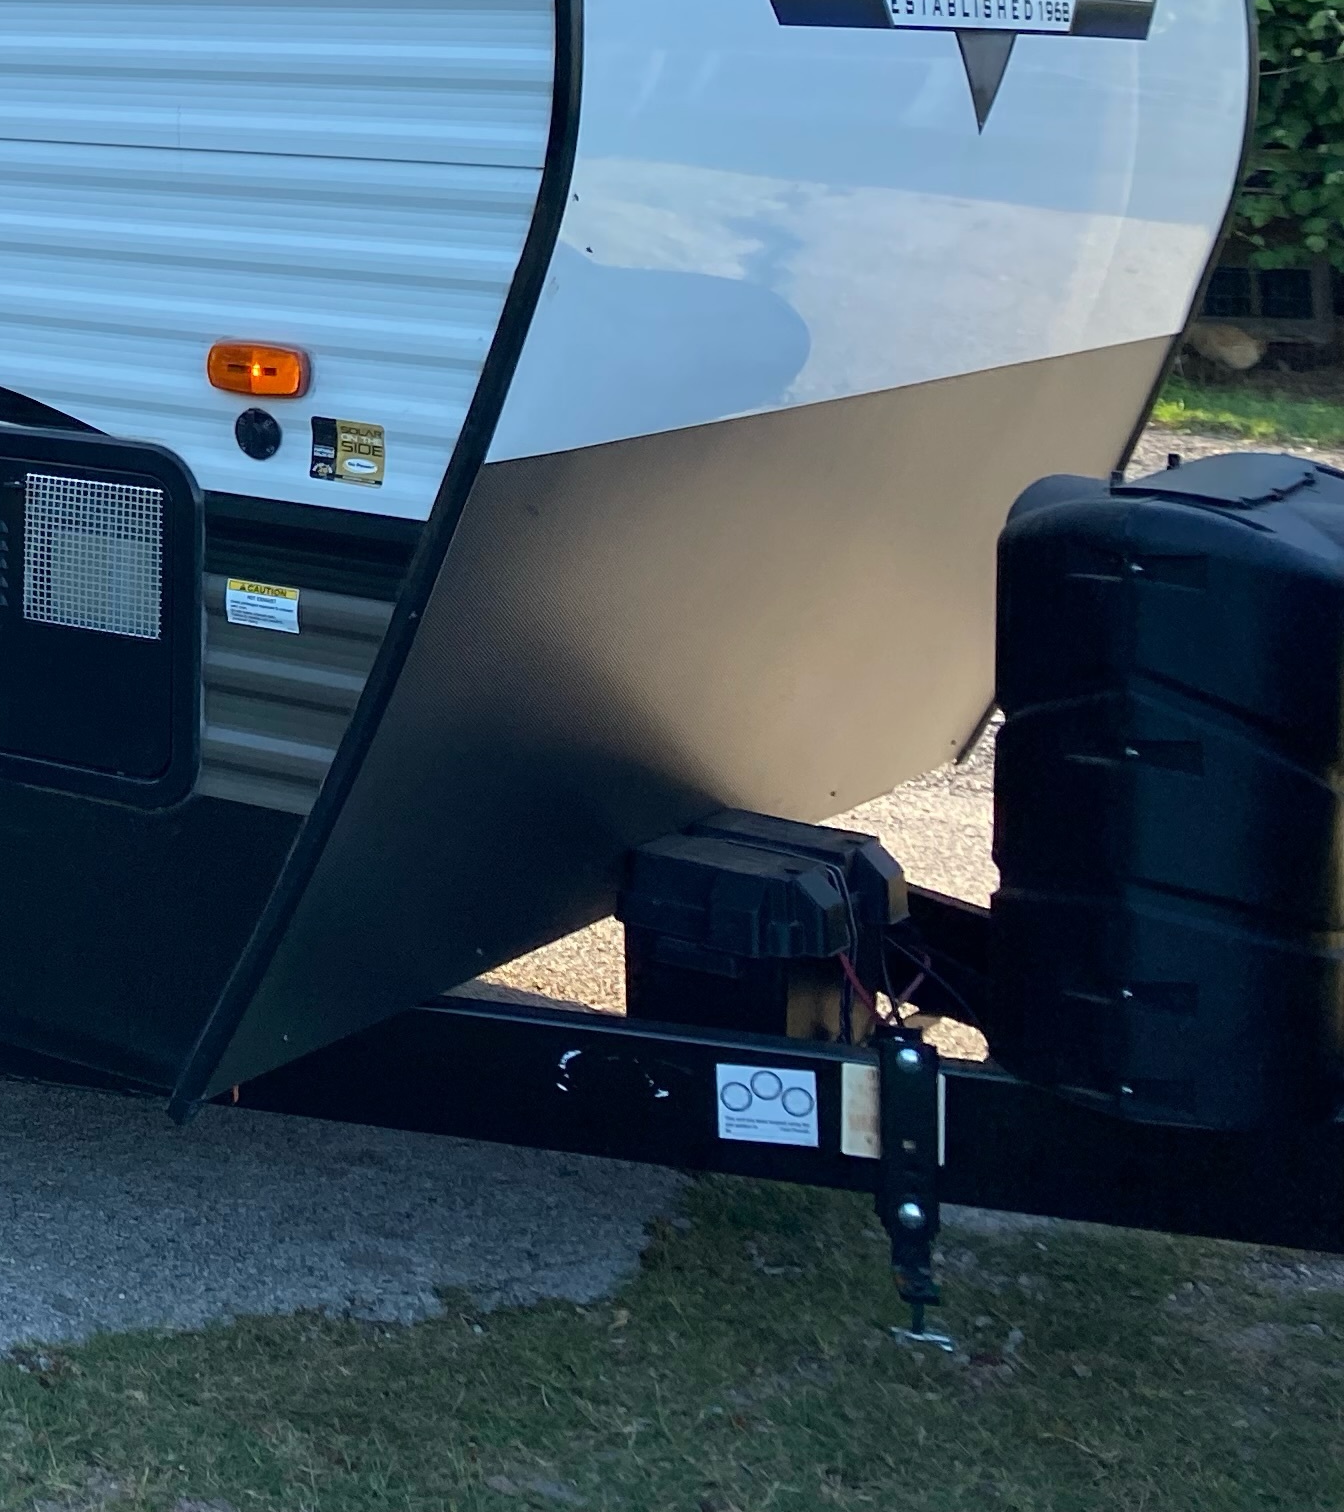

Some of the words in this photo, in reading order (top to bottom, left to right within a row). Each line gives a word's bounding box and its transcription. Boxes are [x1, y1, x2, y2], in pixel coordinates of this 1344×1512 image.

[340, 425, 383, 438] SOLAR
[341, 433, 358, 443] ON
[360, 436, 383, 446] THE
[341, 441, 383, 458] SIDE
[247, 584, 287, 597] CAUTION
